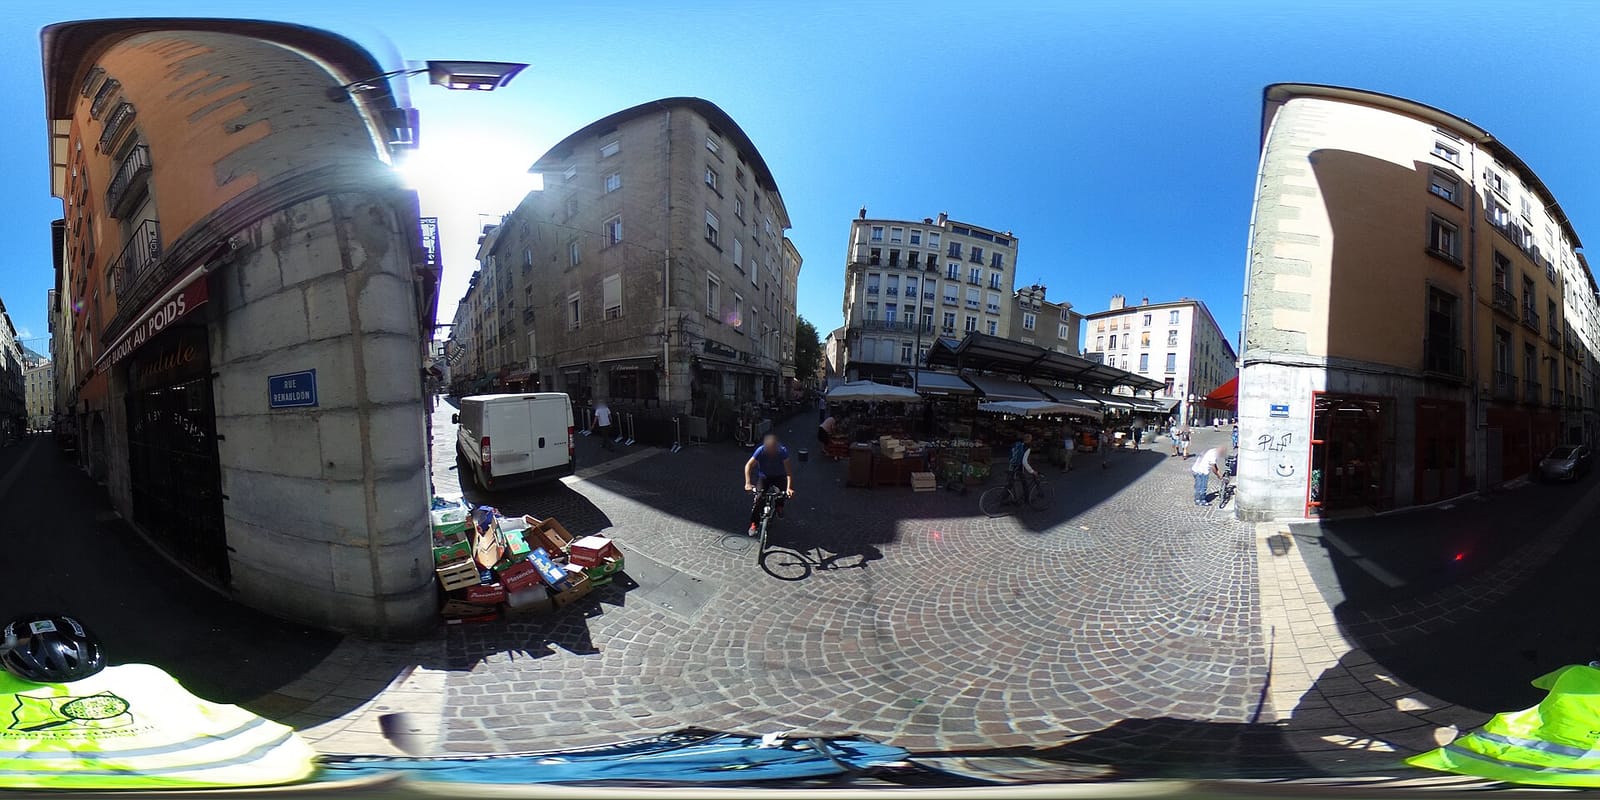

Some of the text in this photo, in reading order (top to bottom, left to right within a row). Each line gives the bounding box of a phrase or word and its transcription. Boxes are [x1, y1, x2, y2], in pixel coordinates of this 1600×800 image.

[112, 342, 133, 364] BIJOUX
[133, 326, 145, 347] AU
[148, 293, 185, 336] POIDS
[284, 379, 296, 389] RUE
[273, 391, 310, 402] RENAULDON
